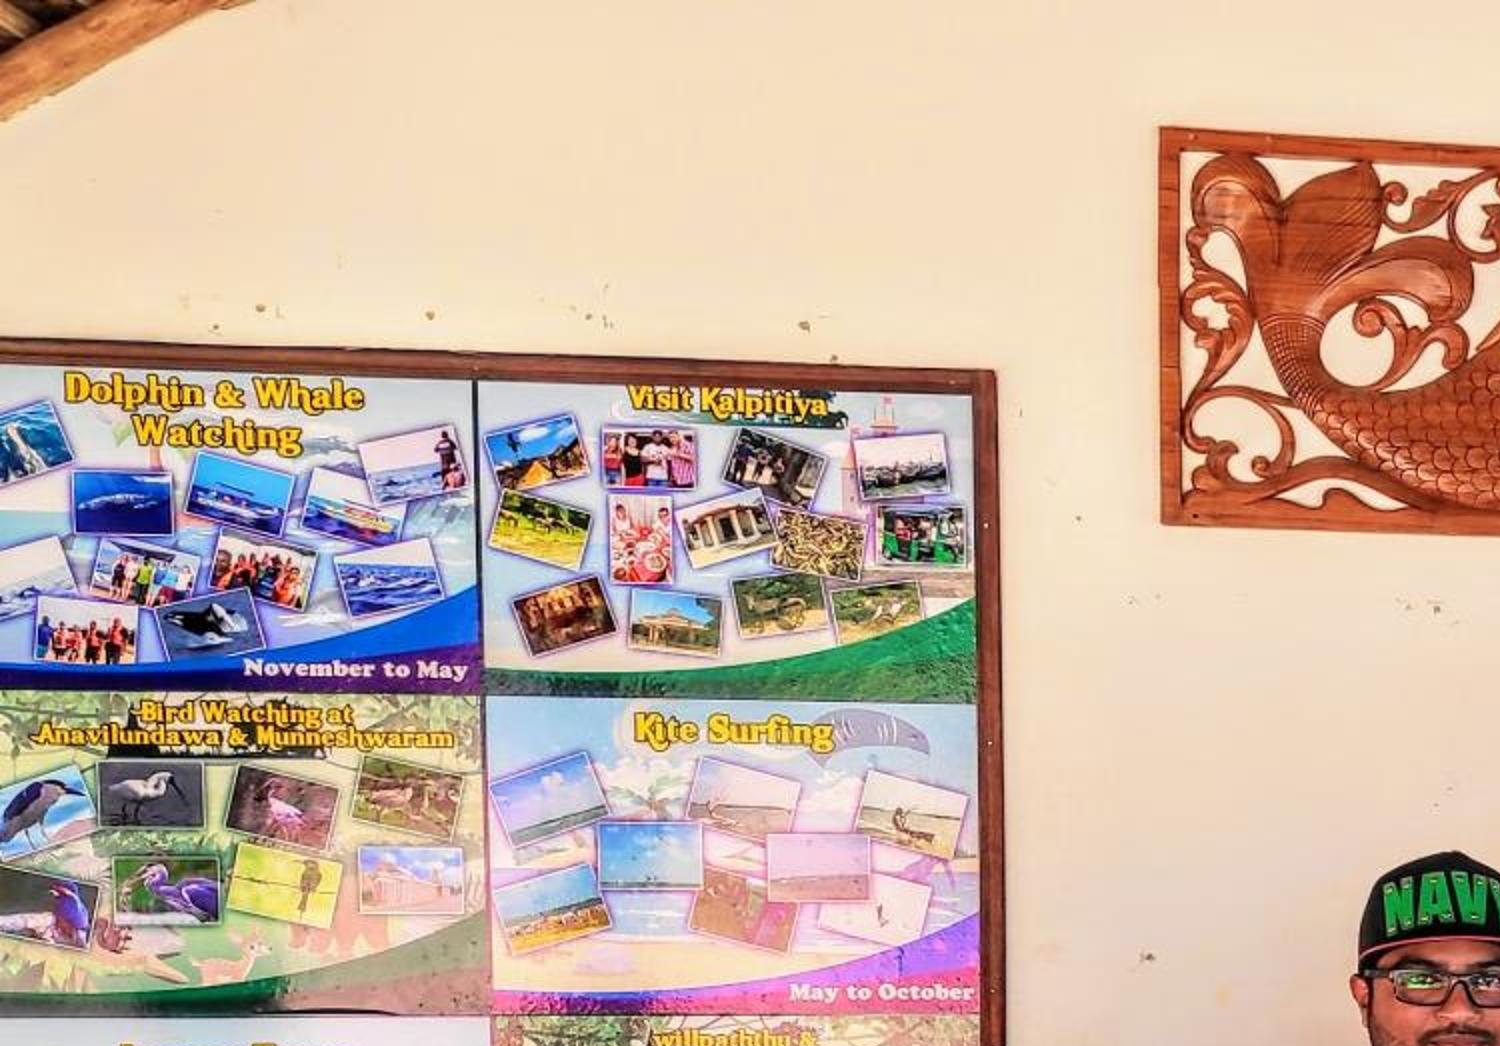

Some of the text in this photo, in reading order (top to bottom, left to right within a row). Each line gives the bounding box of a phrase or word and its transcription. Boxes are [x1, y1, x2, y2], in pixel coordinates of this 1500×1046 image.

[64, 372, 366, 416] Dolphin & Whale
[627, 384, 828, 422] Visit Kalpitiya
[132, 414, 305, 458] Watching
[243, 658, 469, 683] November to May
[132, 700, 354, 729] Bird Watching at
[30, 721, 455, 753] Anavilundawa & Munneshwaram
[634, 711, 836, 755] Kite Surfing
[789, 981, 976, 1005] May to October
